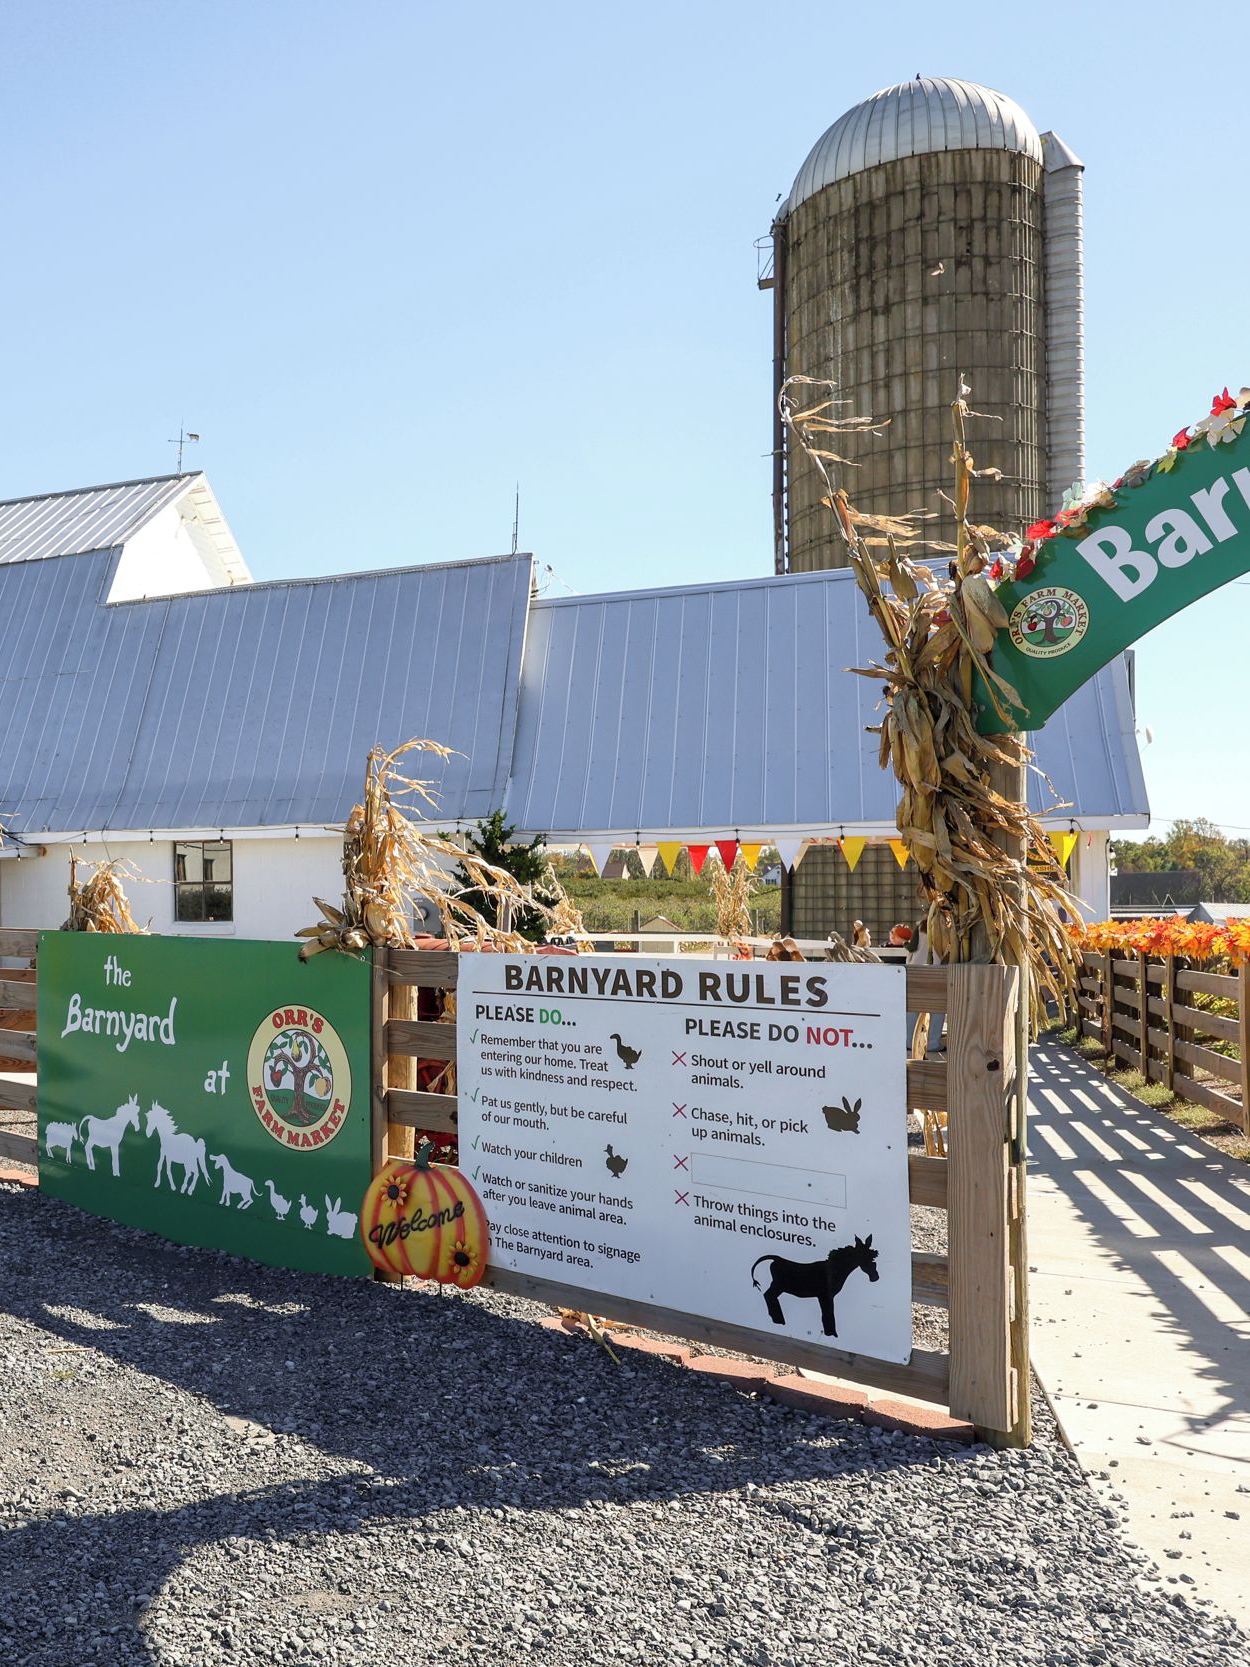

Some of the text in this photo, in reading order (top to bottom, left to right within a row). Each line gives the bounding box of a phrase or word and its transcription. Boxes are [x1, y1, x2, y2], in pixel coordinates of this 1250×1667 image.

[1021, 589, 1057, 607] FARM
[1062, 591, 1087, 636] MARKET
[1026, 647, 1047, 655] QUALITY
[104, 955, 132, 987] the
[505, 965, 829, 1007] BARNYARD RULES
[61, 993, 178, 1052] Barnyard
[273, 1009, 324, 1033] ORR'S
[475, 1005, 576, 1026] PLEASE DO...
[481, 1034, 602, 1054] Remember that you are
[686, 1019, 873, 1049] PLEASE DO NOT...
[481, 1051, 608, 1071] entering our home. Treat
[691, 1055, 826, 1078] Shout or yell around
[204, 1060, 230, 1095] at
[481, 1067, 638, 1092] us with kindness and respect.
[692, 1073, 744, 1088] animals.
[253, 1085, 345, 1147] FARM MARKET
[482, 1096, 627, 1124] Pat us gently, but be careful
[482, 1112, 549, 1130] of our mouth.
[691, 1108, 809, 1133] Chase, hit, or pick
[692, 1127, 765, 1146] up animals.
[482, 1142, 583, 1168] Watch your children
[482, 1173, 634, 1209] Watch or sanitize your hands
[483, 1189, 627, 1225] after you leave animal area.
[694, 1195, 836, 1231] Throw things into the
[369, 1201, 465, 1248] Welcome
[694, 1216, 816, 1247] animal enclosures.
[488, 1237, 594, 1268] n The Barnyard area.
[504, 1224, 530, 1238] close
[532, 1231, 580, 1248] attention
[583, 1240, 595, 1251] to
[598, 1243, 641, 1263] signage
